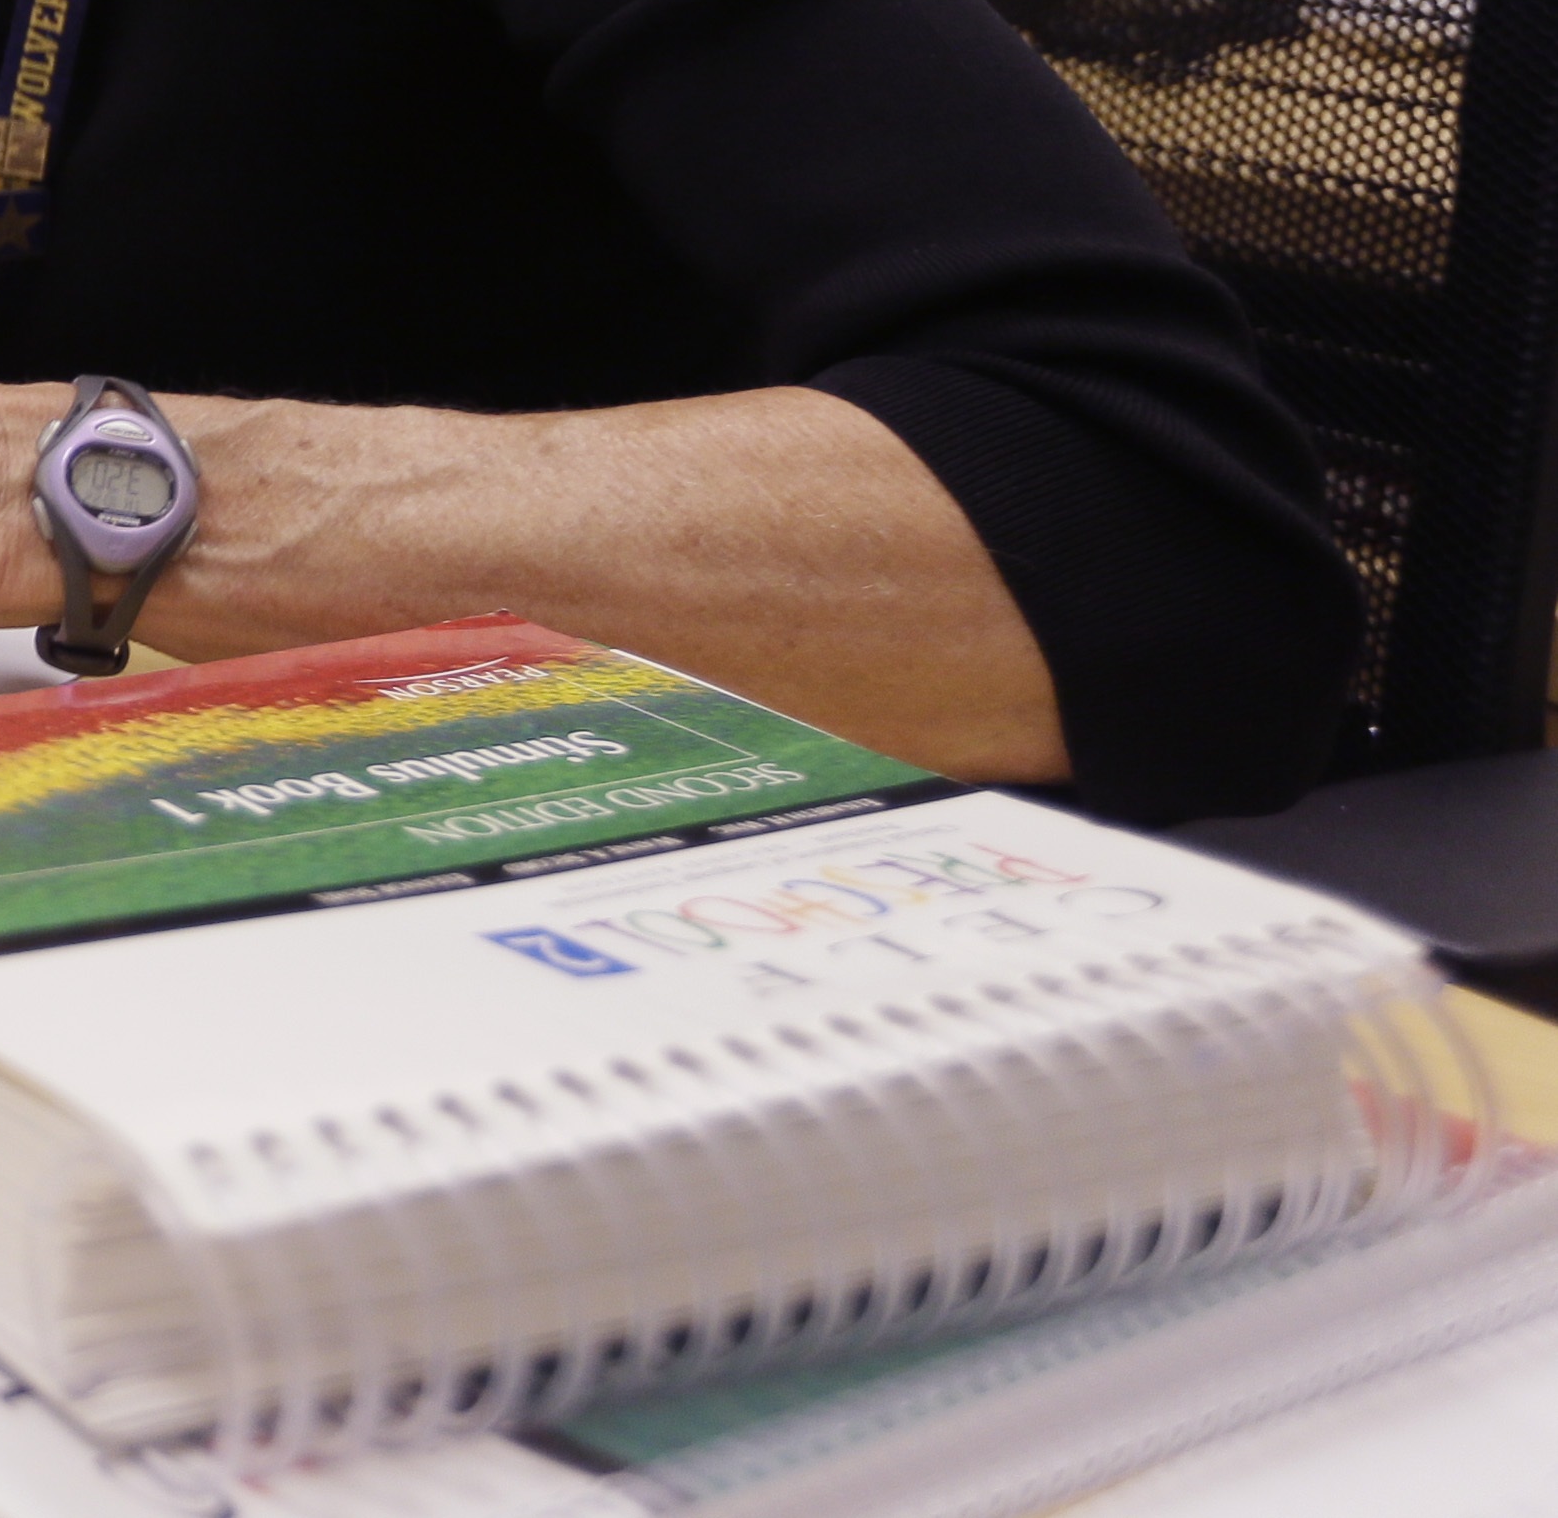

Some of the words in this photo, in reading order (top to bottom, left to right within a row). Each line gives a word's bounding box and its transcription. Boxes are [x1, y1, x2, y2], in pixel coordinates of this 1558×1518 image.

[380, 664, 550, 702] PEARSON
[366, 730, 630, 785] Stimulus
[149, 798, 206, 825] 1
[196, 770, 380, 817] Book
[604, 762, 806, 812] SECOND
[406, 794, 615, 843] EDITION
[573, 843, 1093, 957] PRESCHOOL
